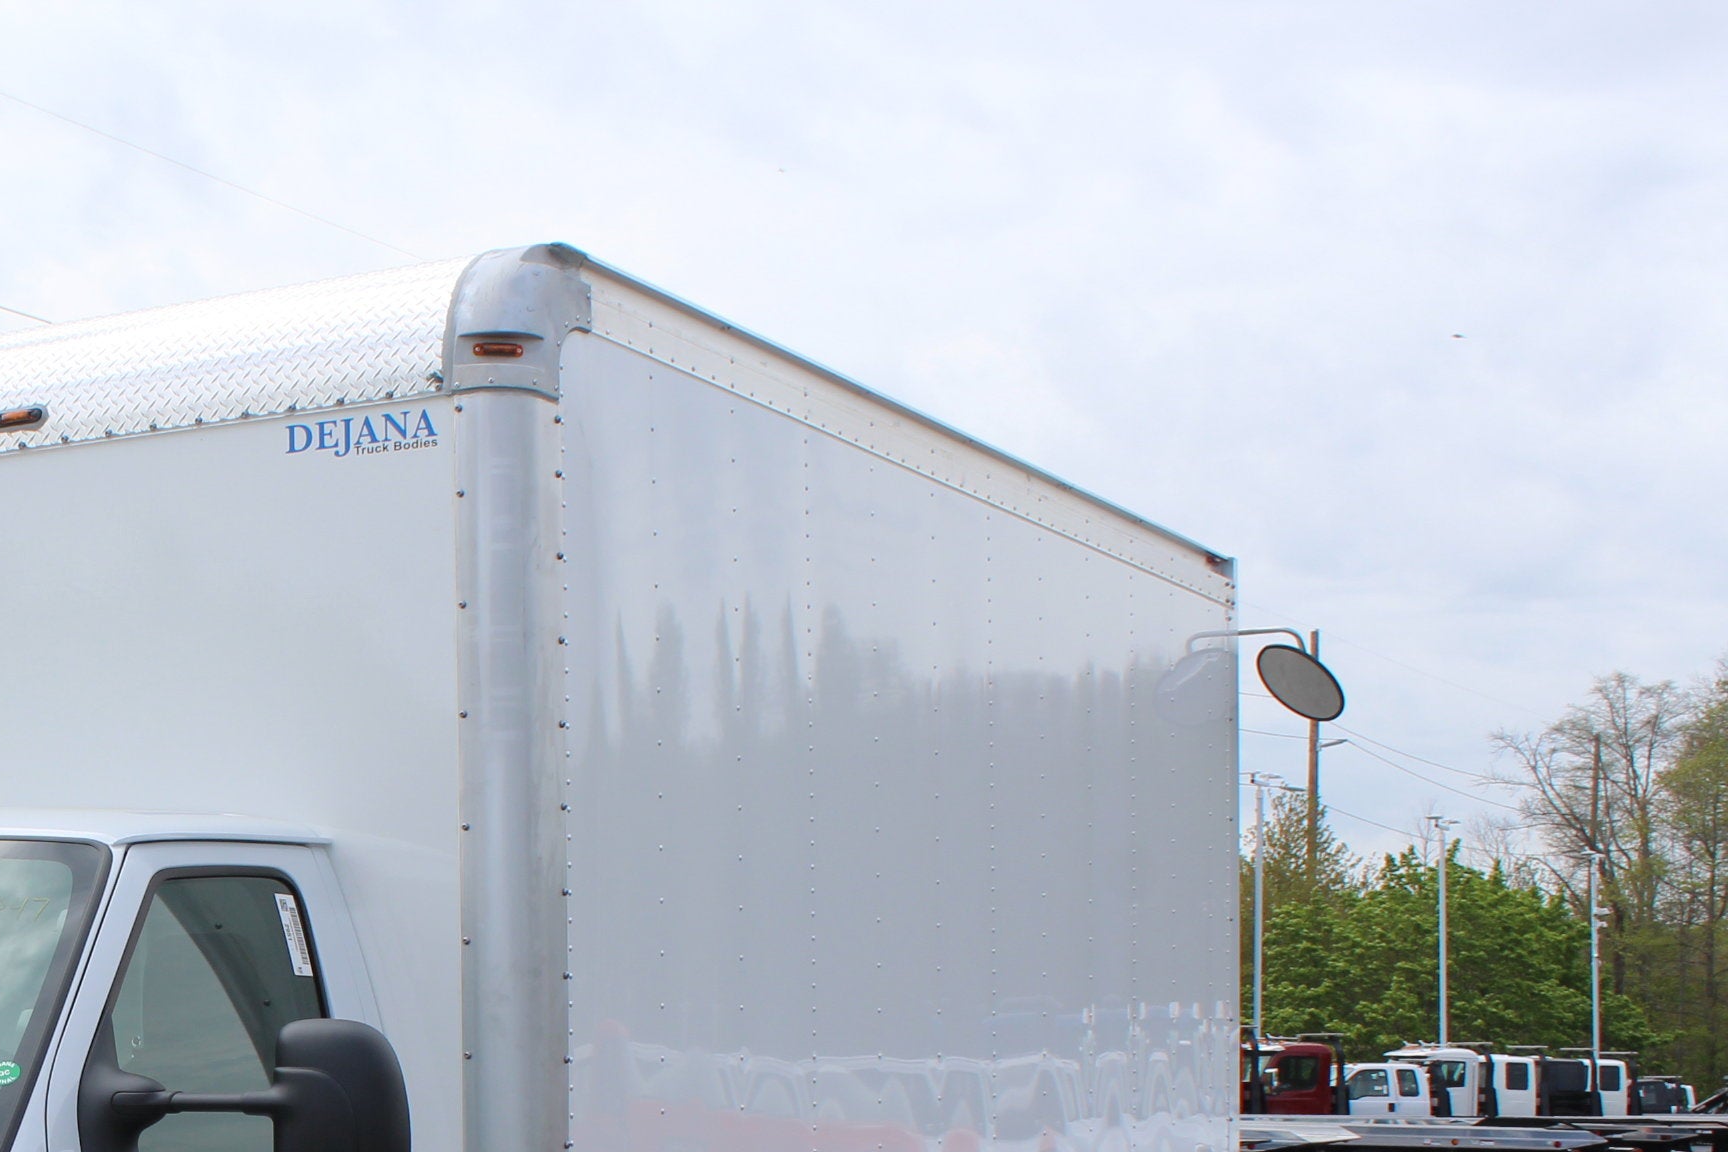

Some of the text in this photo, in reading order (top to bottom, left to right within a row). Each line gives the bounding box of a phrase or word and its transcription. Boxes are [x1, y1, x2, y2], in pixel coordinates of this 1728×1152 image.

[285, 408, 439, 457] DEJANA
[353, 438, 439, 456] Truck Bodies
